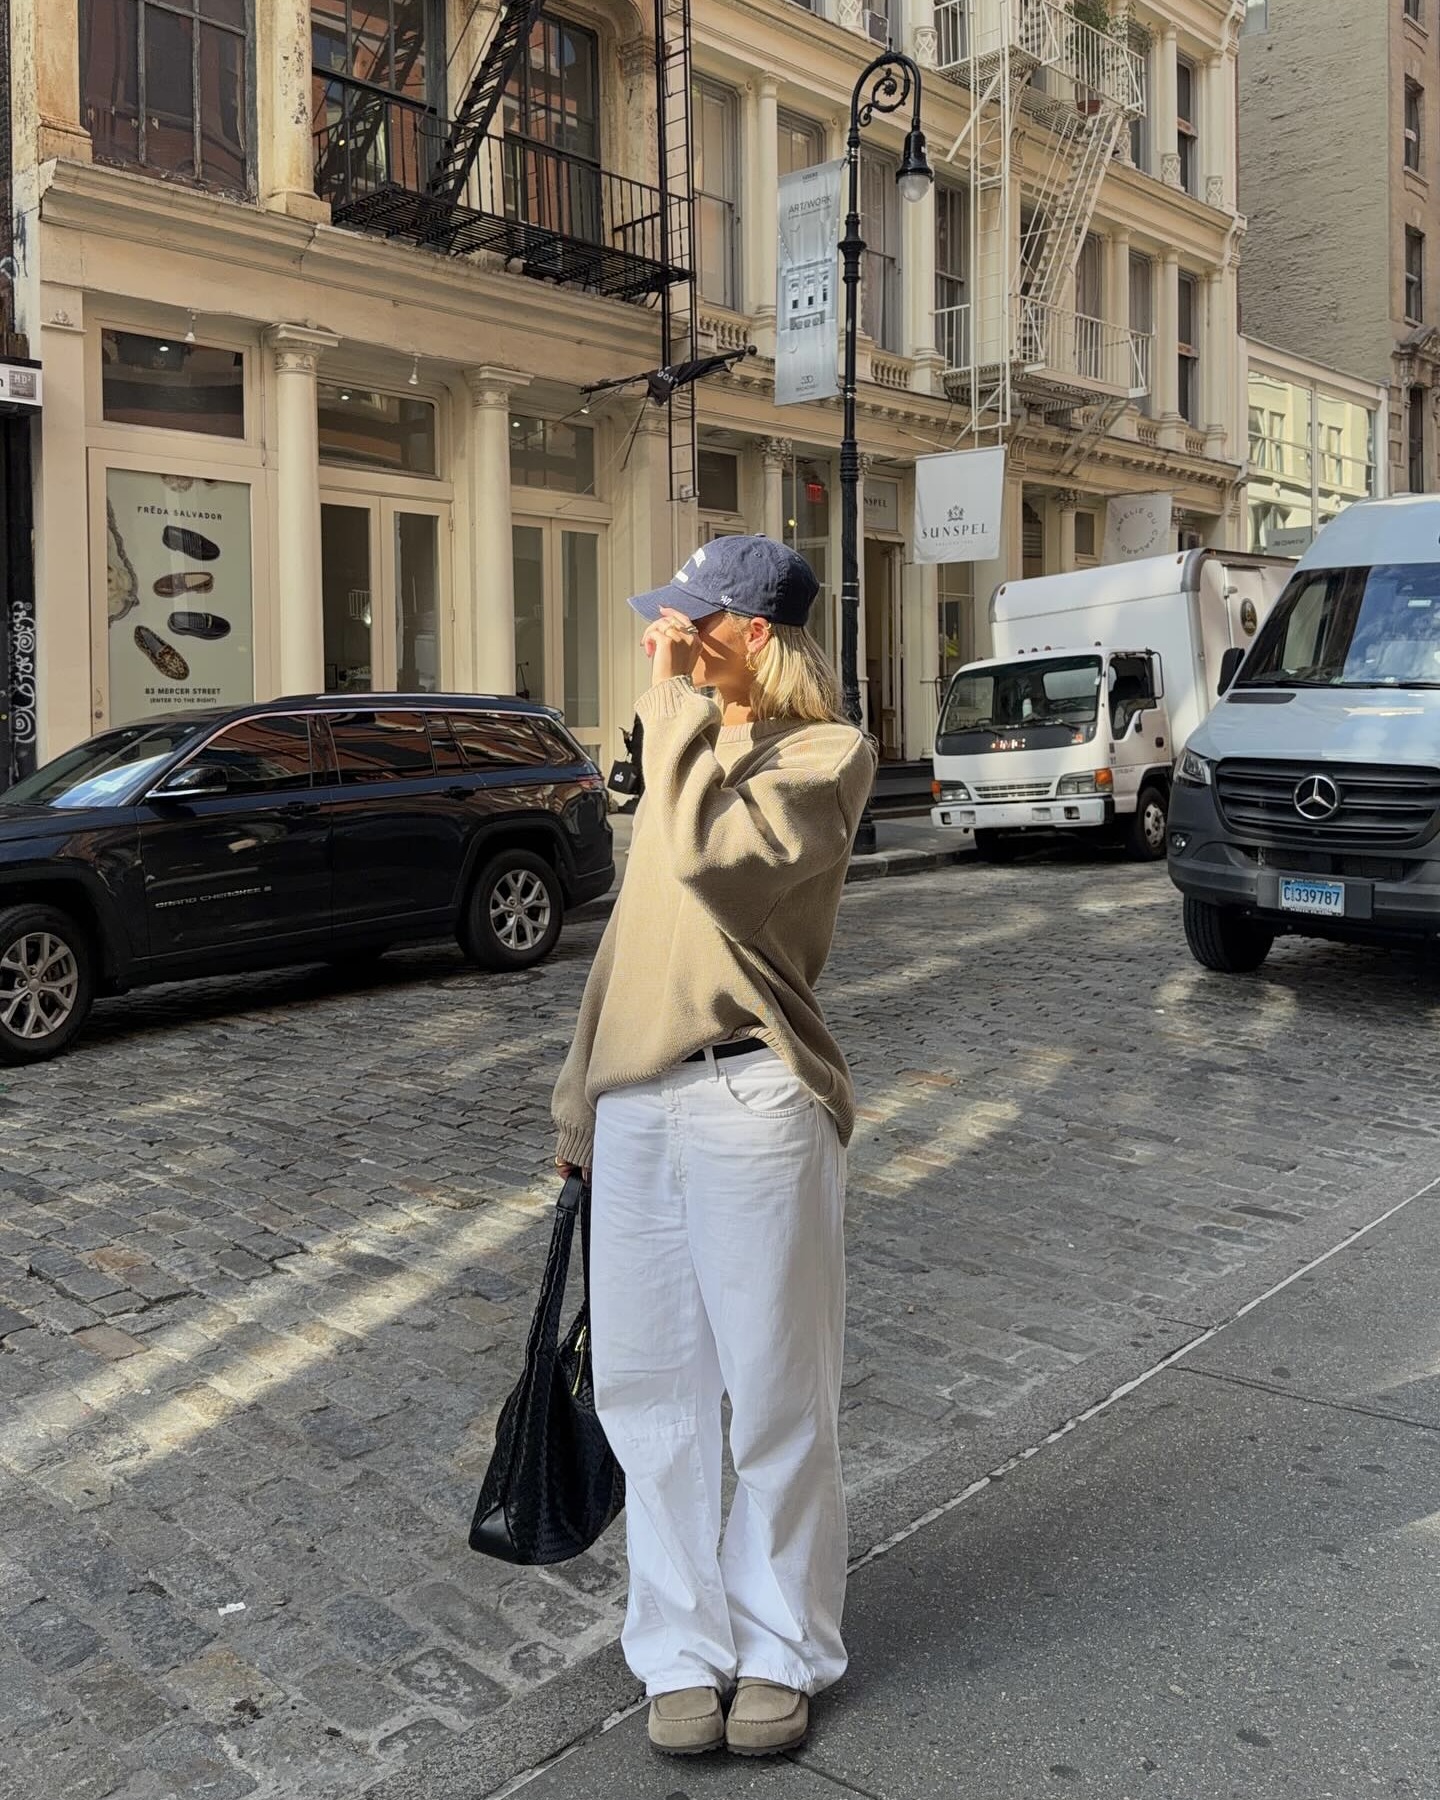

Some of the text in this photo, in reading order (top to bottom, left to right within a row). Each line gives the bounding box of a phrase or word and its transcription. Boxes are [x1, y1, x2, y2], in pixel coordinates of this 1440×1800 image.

[174, 509, 222, 520] SALVADOR
[921, 523, 989, 540] SUNSPEL
[199, 887, 262, 901] CHEROKEE
